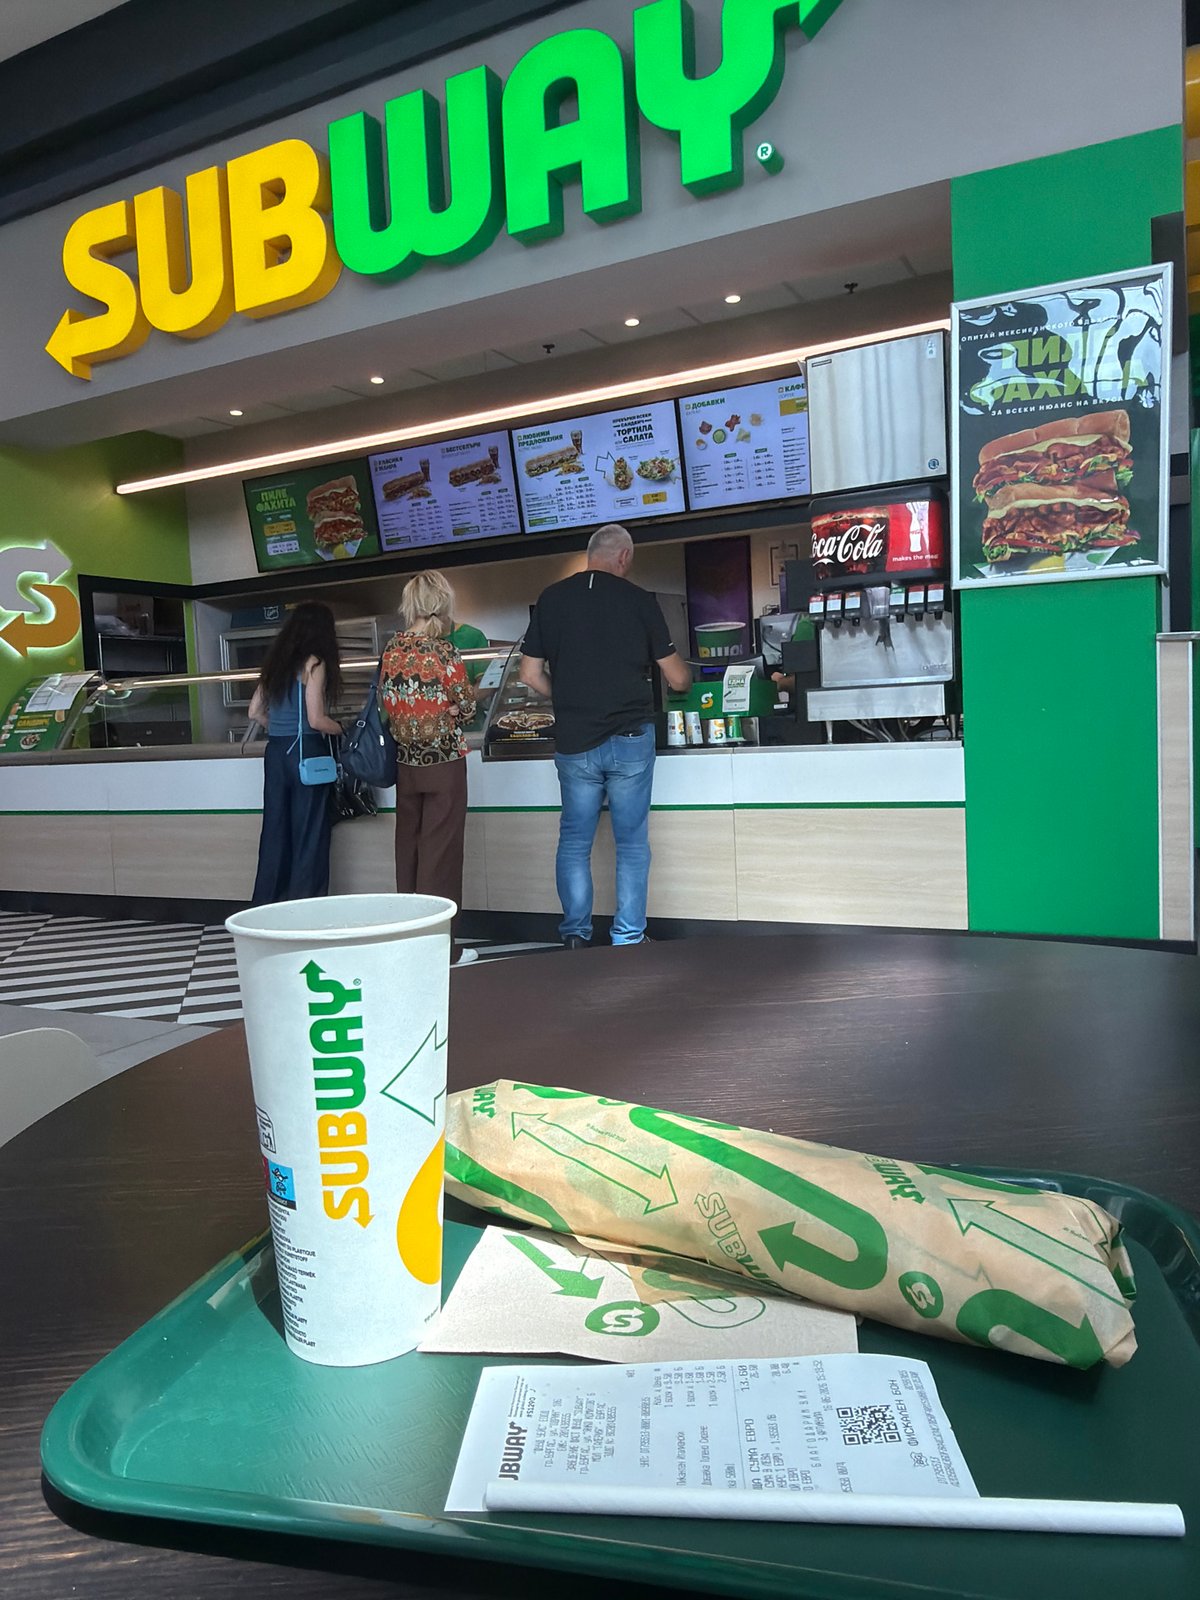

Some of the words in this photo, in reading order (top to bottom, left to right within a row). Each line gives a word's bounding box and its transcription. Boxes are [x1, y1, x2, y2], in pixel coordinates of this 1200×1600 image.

[46, 0, 847, 381] SUBWAY
[961, 331, 996, 342] ОПИТАЙ
[969, 360, 1149, 406] ФАХИА
[691, 397, 725, 410] ДОБАВКИ
[991, 408, 1002, 416] ЗА
[1006, 404, 1036, 415] ВСЕКИ
[1038, 401, 1073, 412] НЮАНС
[1076, 400, 1089, 408] НА
[522, 430, 550, 441] ЛЮБИМИ
[616, 424, 653, 436] ТОРТИЛА
[518, 434, 563, 447] ПРЕДЛОЖЕНИЯ
[622, 432, 654, 443] САЛАТА
[261, 488, 288, 502] ПИЛЕ
[255, 499, 296, 513] ФАХИТА
[299, 959, 376, 1230] SUBWAY
[738, 1365, 750, 1391] 13.60
[889, 1380, 902, 1395] БОН
[744, 1419, 756, 1442] ЕВРО
[894, 1400, 919, 1447] ФИСКАЛЕН
[748, 1448, 760, 1472] СУМА
[772, 1453, 784, 1466] ЕВРО
[787, 1468, 799, 1481] ЕВРО
[800, 1470, 812, 1484] ЕВРО
